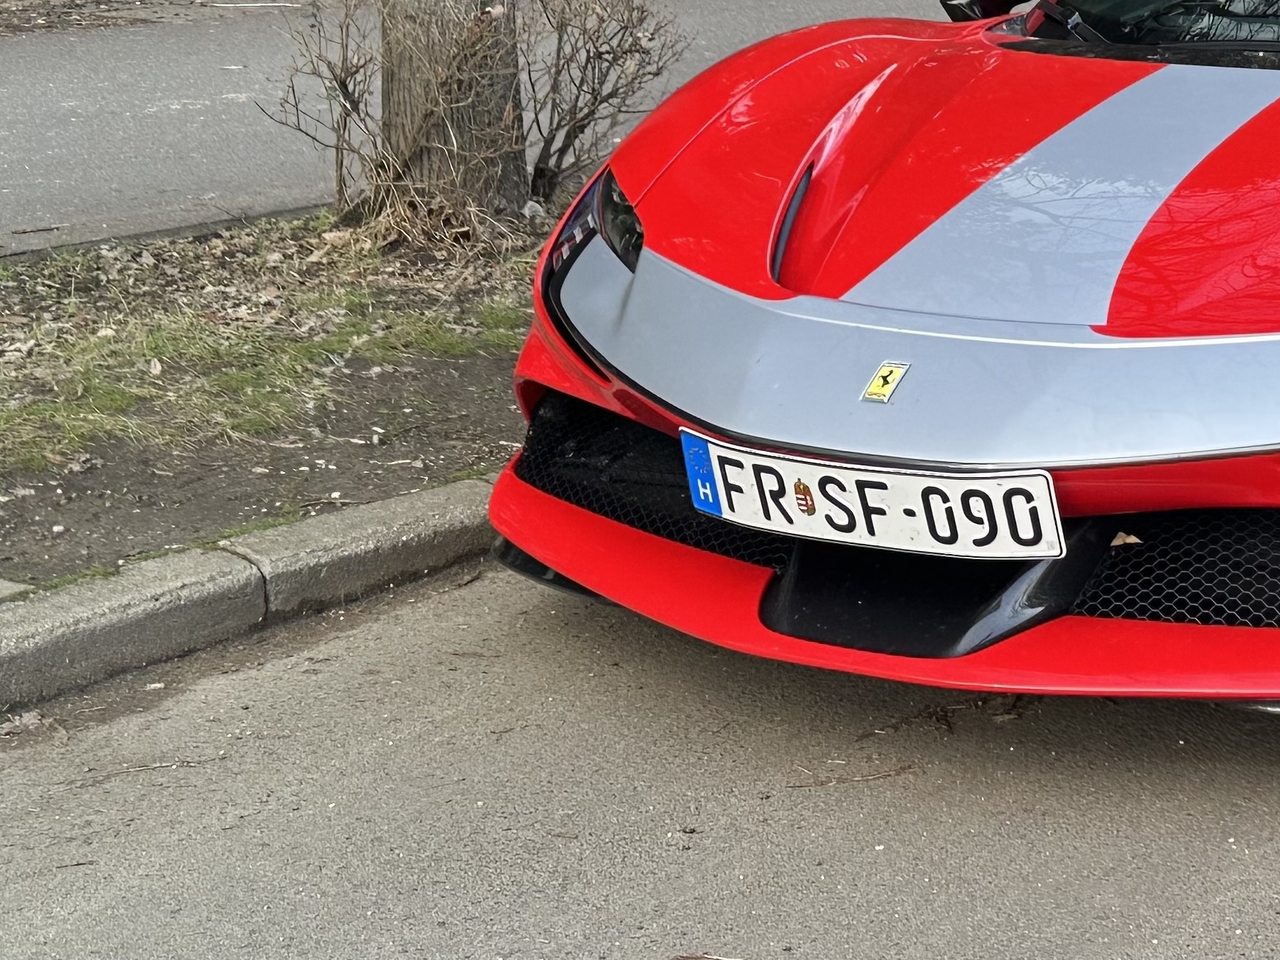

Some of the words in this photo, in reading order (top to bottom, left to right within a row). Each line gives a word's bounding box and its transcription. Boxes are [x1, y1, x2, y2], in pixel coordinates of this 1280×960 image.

[697, 478, 713, 504] H
[716, 454, 794, 525] FR
[817, 475, 1043, 547] SF-090
